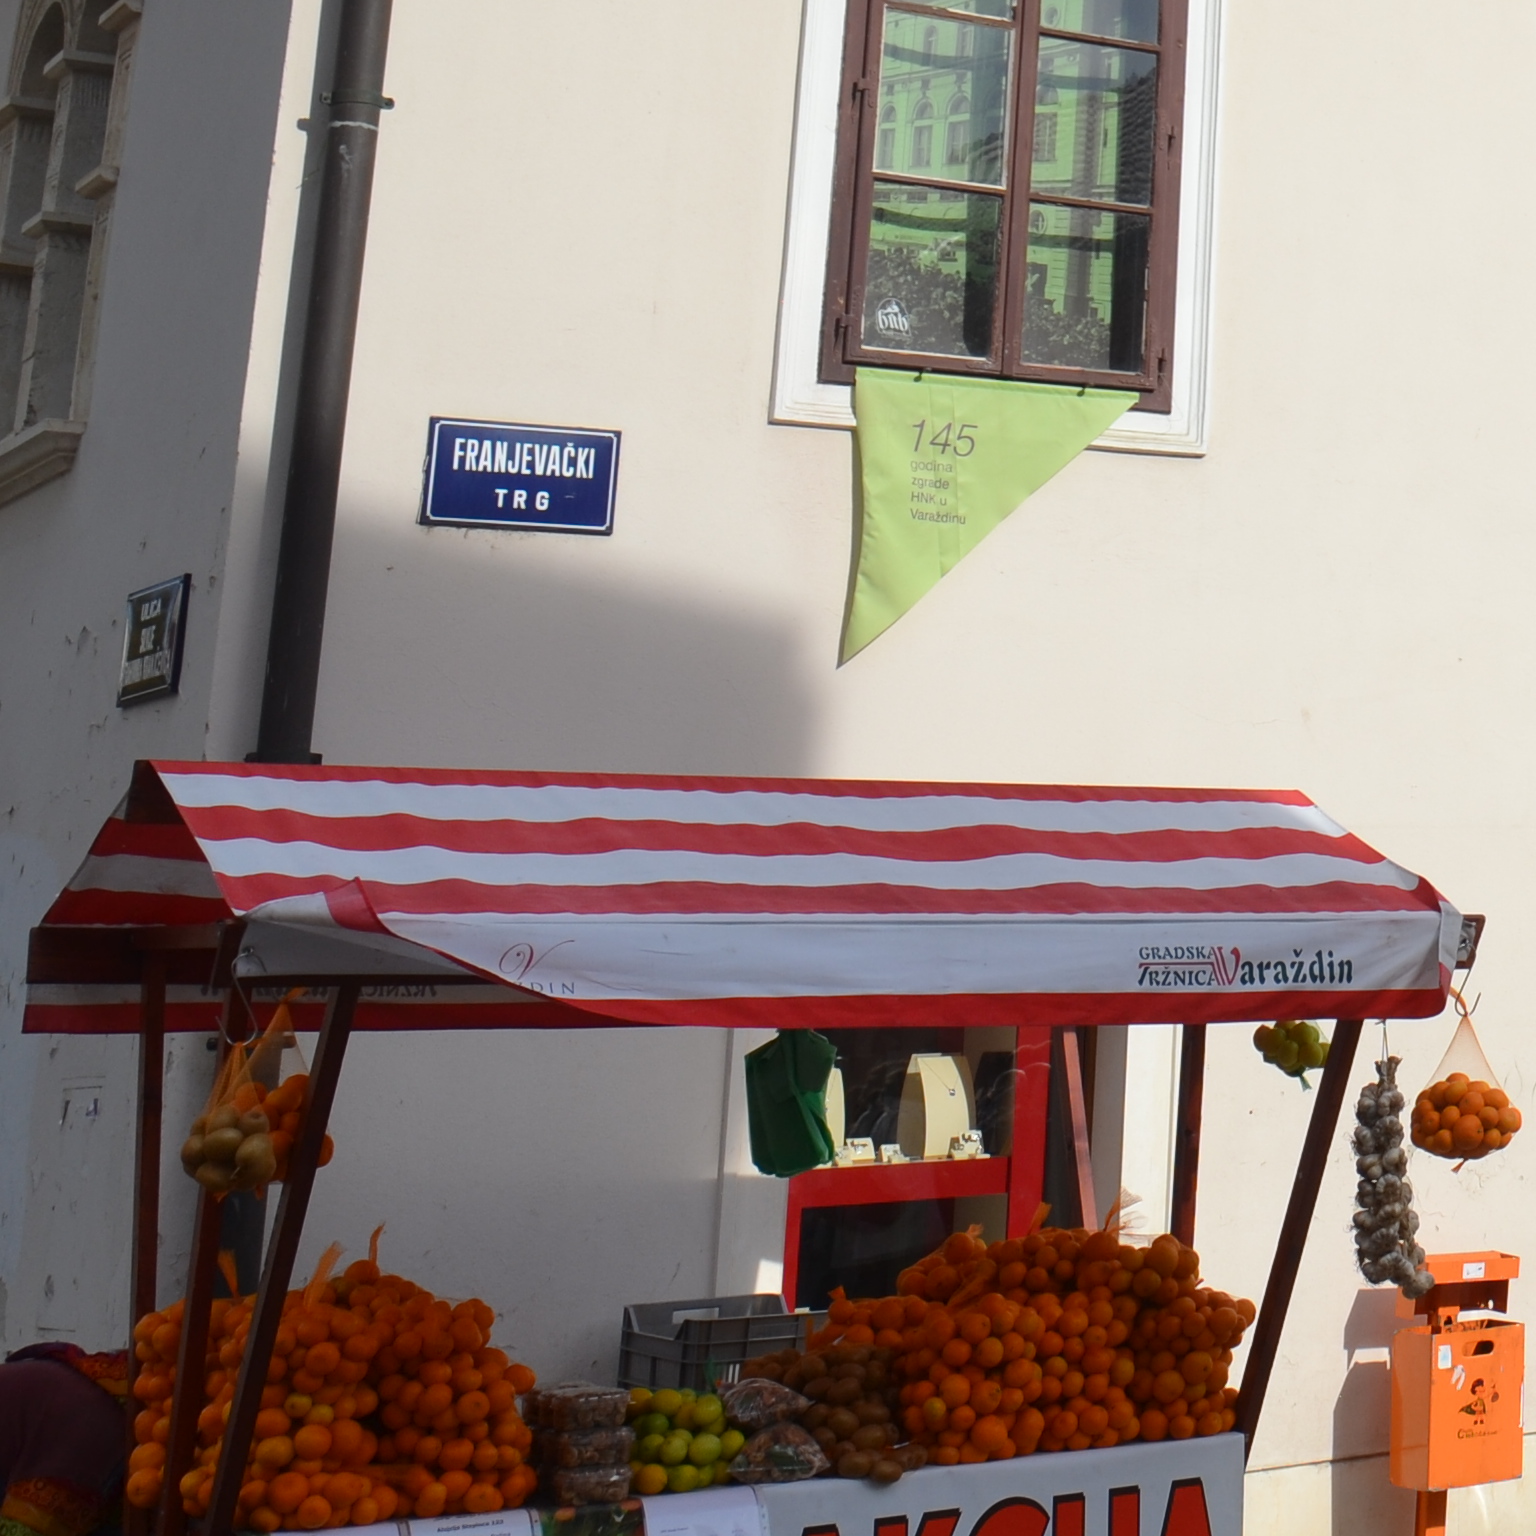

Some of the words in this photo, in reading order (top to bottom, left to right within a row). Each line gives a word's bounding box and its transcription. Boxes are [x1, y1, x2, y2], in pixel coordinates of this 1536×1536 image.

[912, 419, 978, 457] 145
[452, 437, 596, 479] FRANJEVAČKI
[910, 460, 953, 473] godina
[911, 476, 950, 490] zgrade
[495, 488, 550, 511] TRG
[910, 491, 936, 504] HNK
[940, 497, 948, 506] u
[910, 508, 966, 525] Varaždinu
[1138, 946, 1216, 961] GRADSKA
[1138, 965, 1217, 986] TRŽNICA
[1213, 946, 1353, 986] Varaždin
